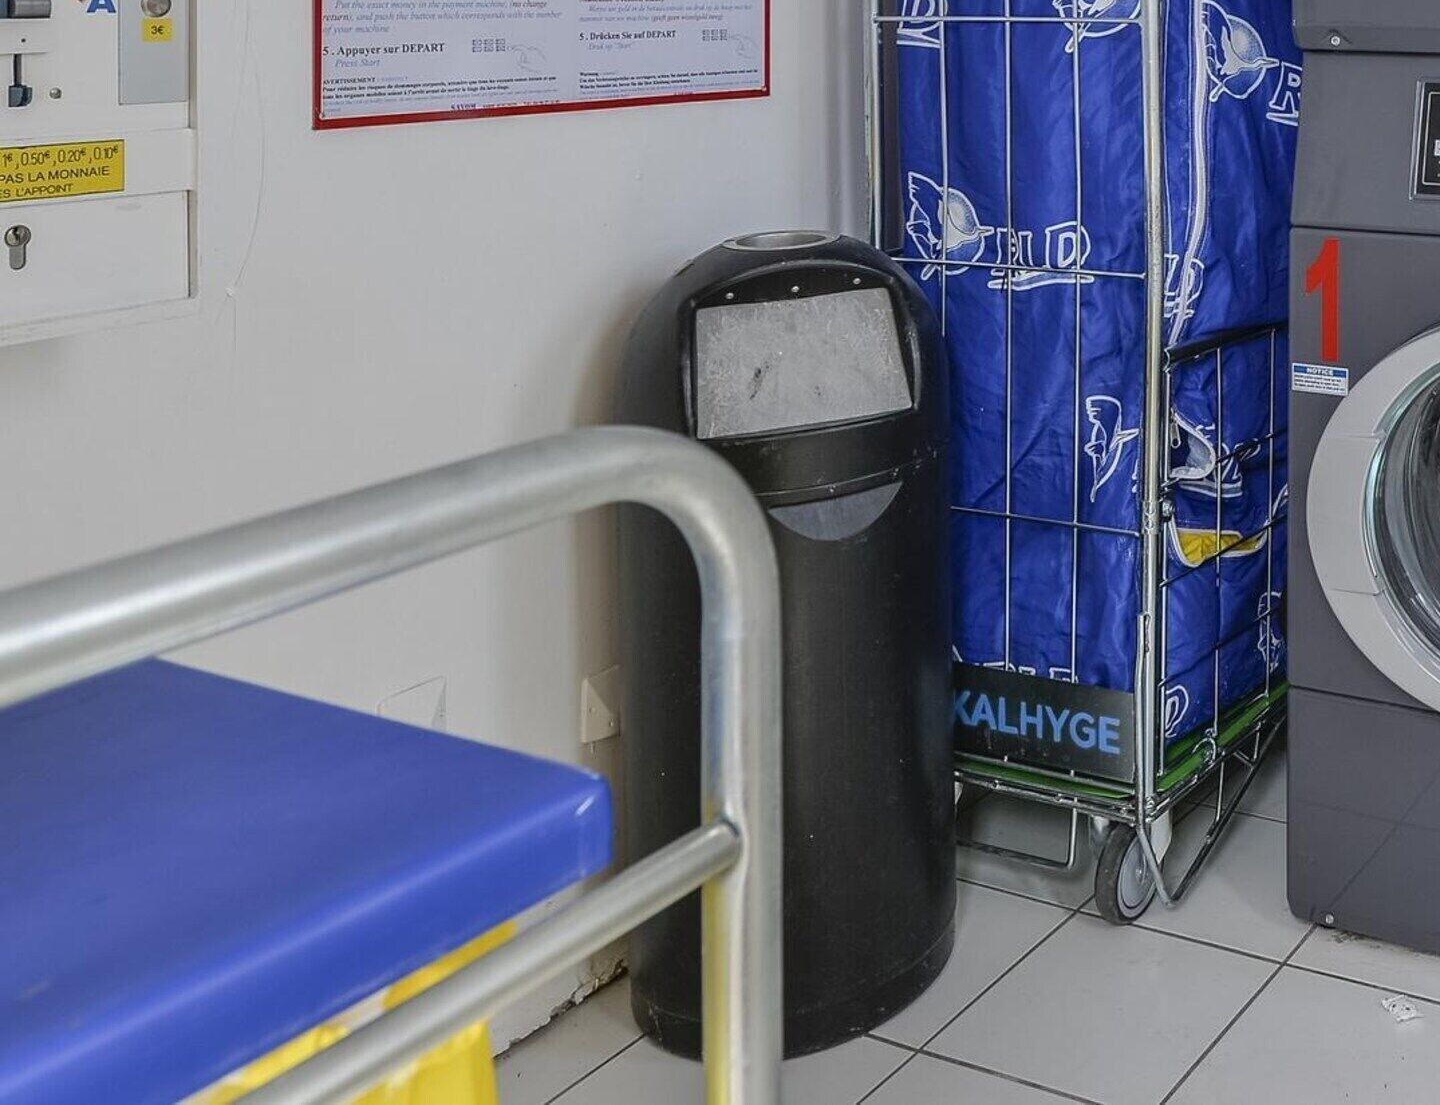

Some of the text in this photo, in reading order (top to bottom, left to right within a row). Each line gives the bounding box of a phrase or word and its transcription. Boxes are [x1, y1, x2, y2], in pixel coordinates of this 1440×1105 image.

[151, 26, 165, 35] 3€
[337, 46, 380, 57] Appuyer
[402, 44, 445, 53] DEPART
[28, 171, 46, 182] LA
[48, 166, 110, 180] MONNAIE
[1306, 238, 1339, 362] 1
